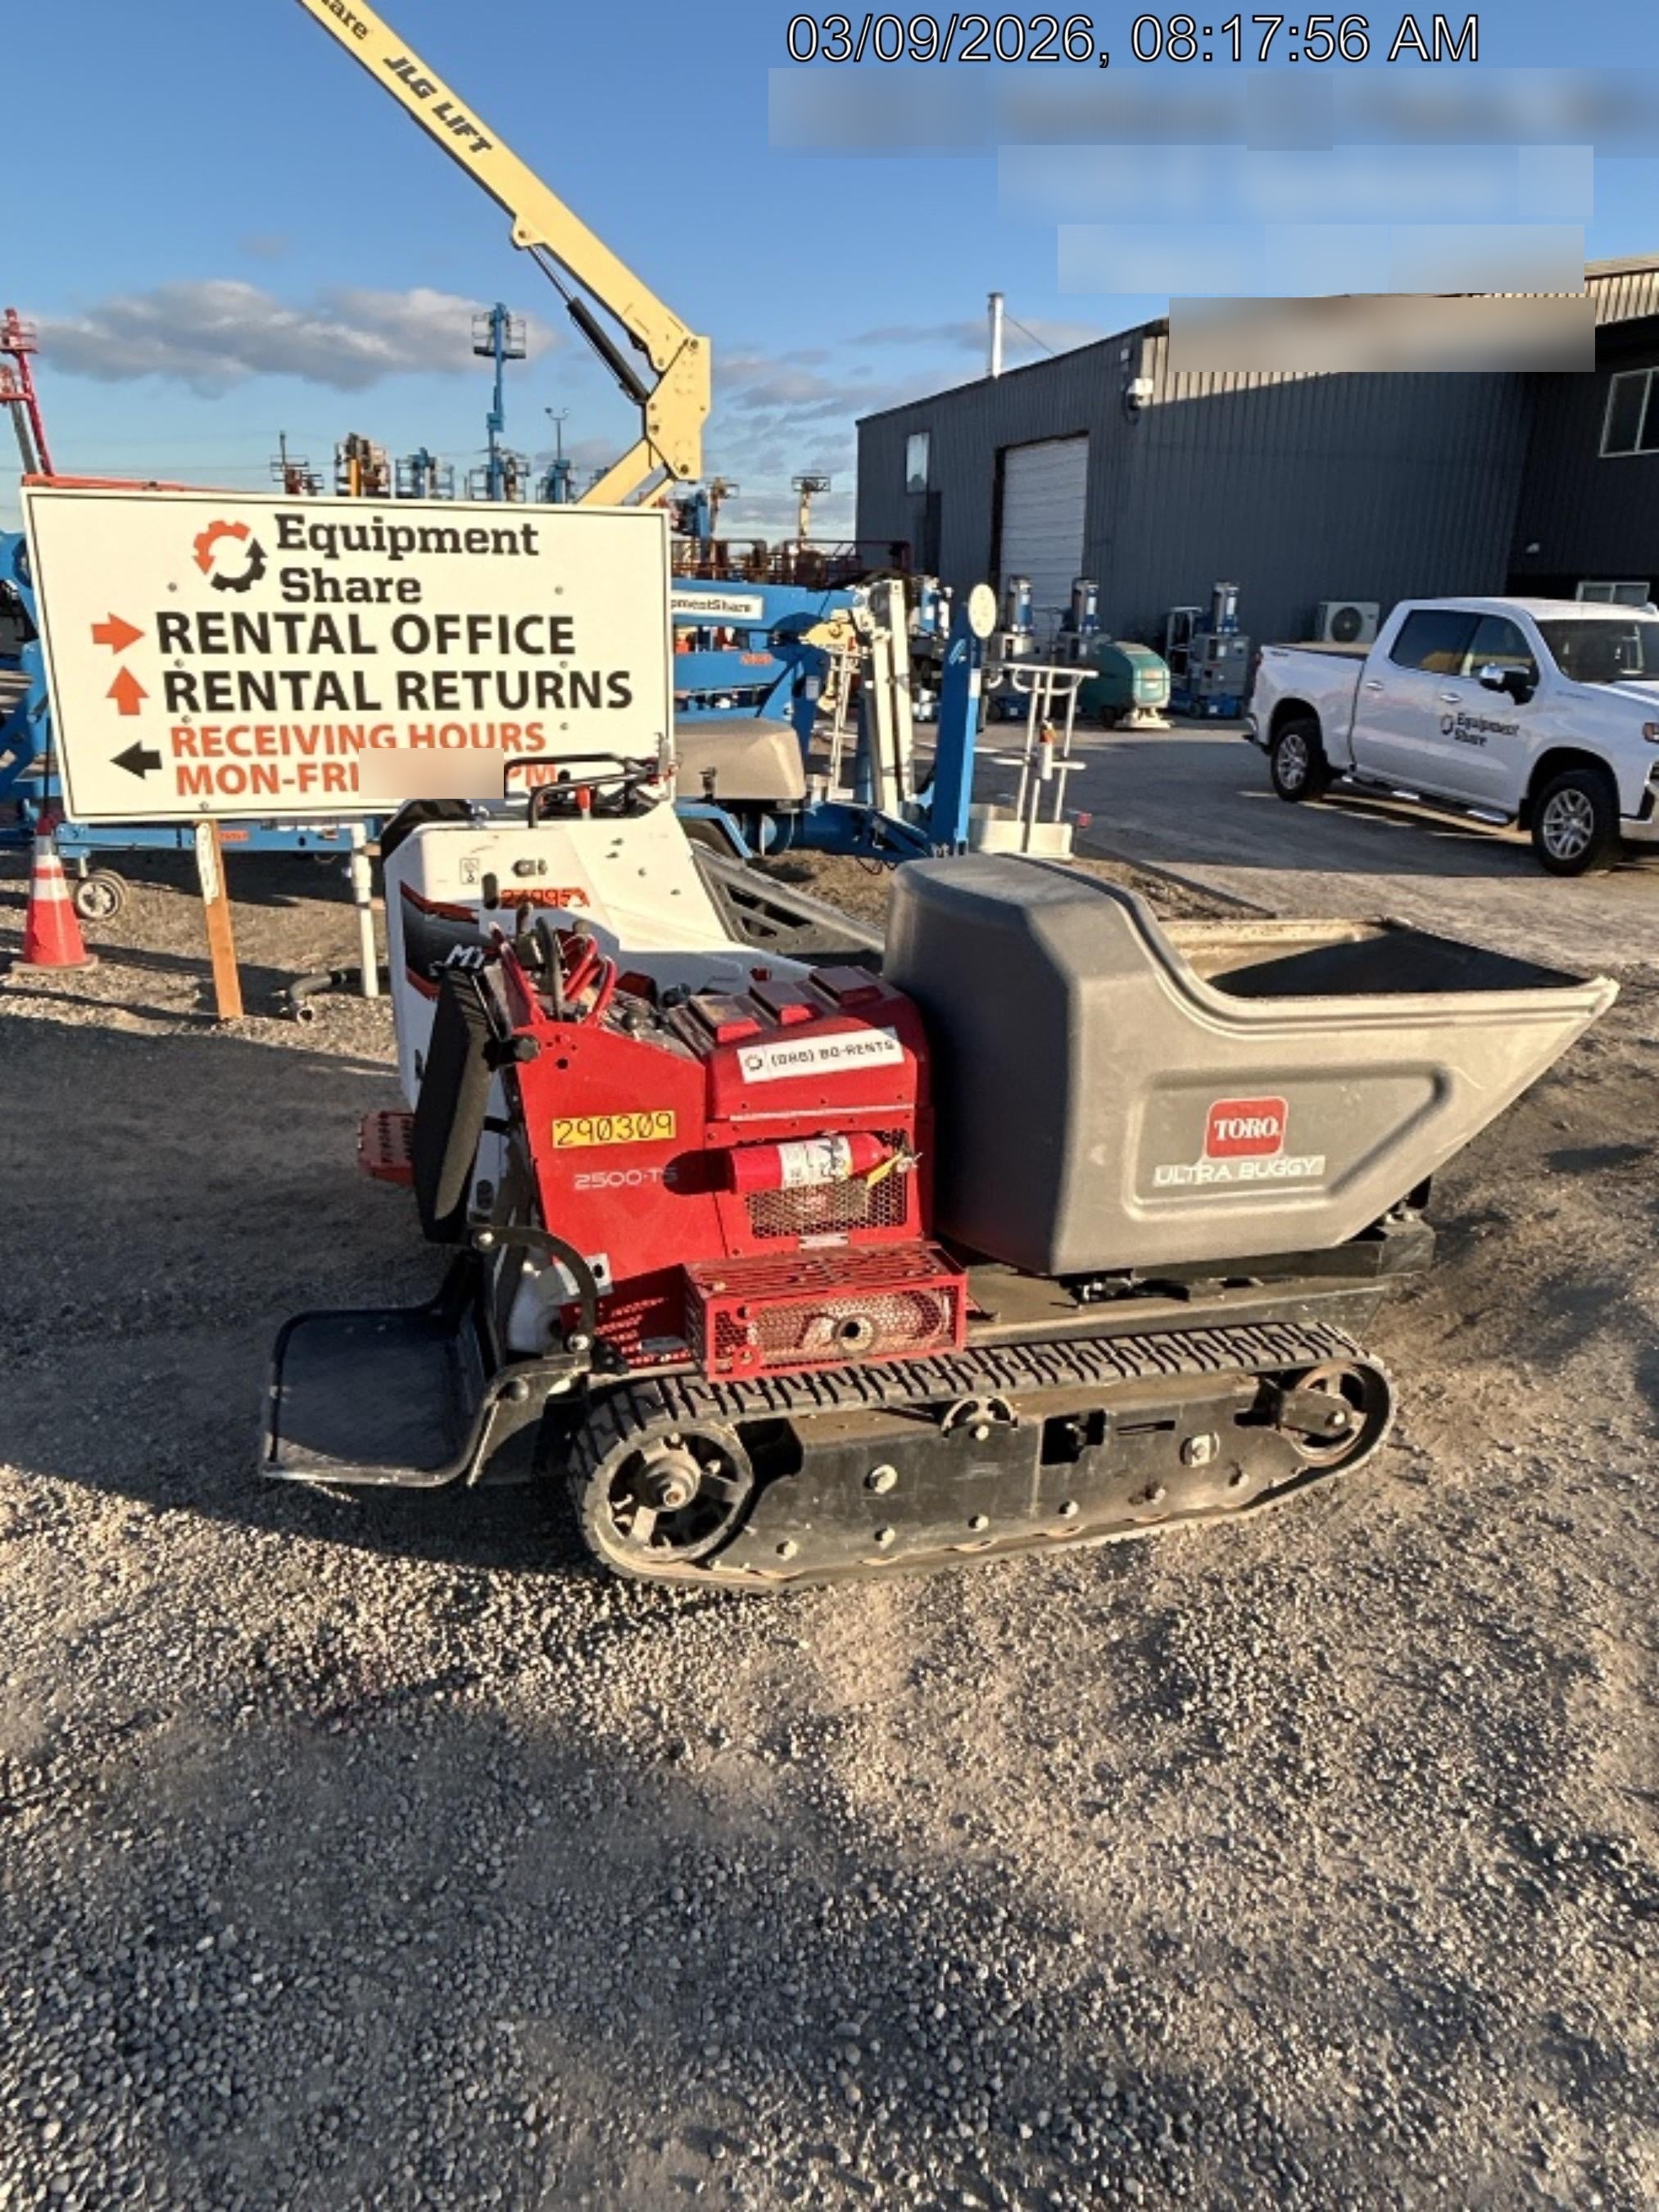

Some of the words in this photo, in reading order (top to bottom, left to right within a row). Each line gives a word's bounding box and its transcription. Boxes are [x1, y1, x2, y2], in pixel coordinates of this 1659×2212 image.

[383, 56, 438, 99] JLG
[432, 100, 493, 153] LIFT
[275, 514, 539, 561] Equipment
[280, 568, 422, 604] Share
[156, 611, 377, 655] RENTAL
[392, 614, 575, 655] OFFICE
[164, 671, 382, 713] RENTAL
[397, 670, 633, 710] RETURNS
[170, 724, 397, 758] RECEIVING
[410, 722, 546, 753] HOURS
[176, 762, 359, 796] MON-FRI
[555, 1113, 673, 1145] 290309
[1214, 1116, 1279, 1140] TORO
[1154, 1162, 1233, 1184] ULTRA
[1239, 1158, 1317, 1180] BUGGY
